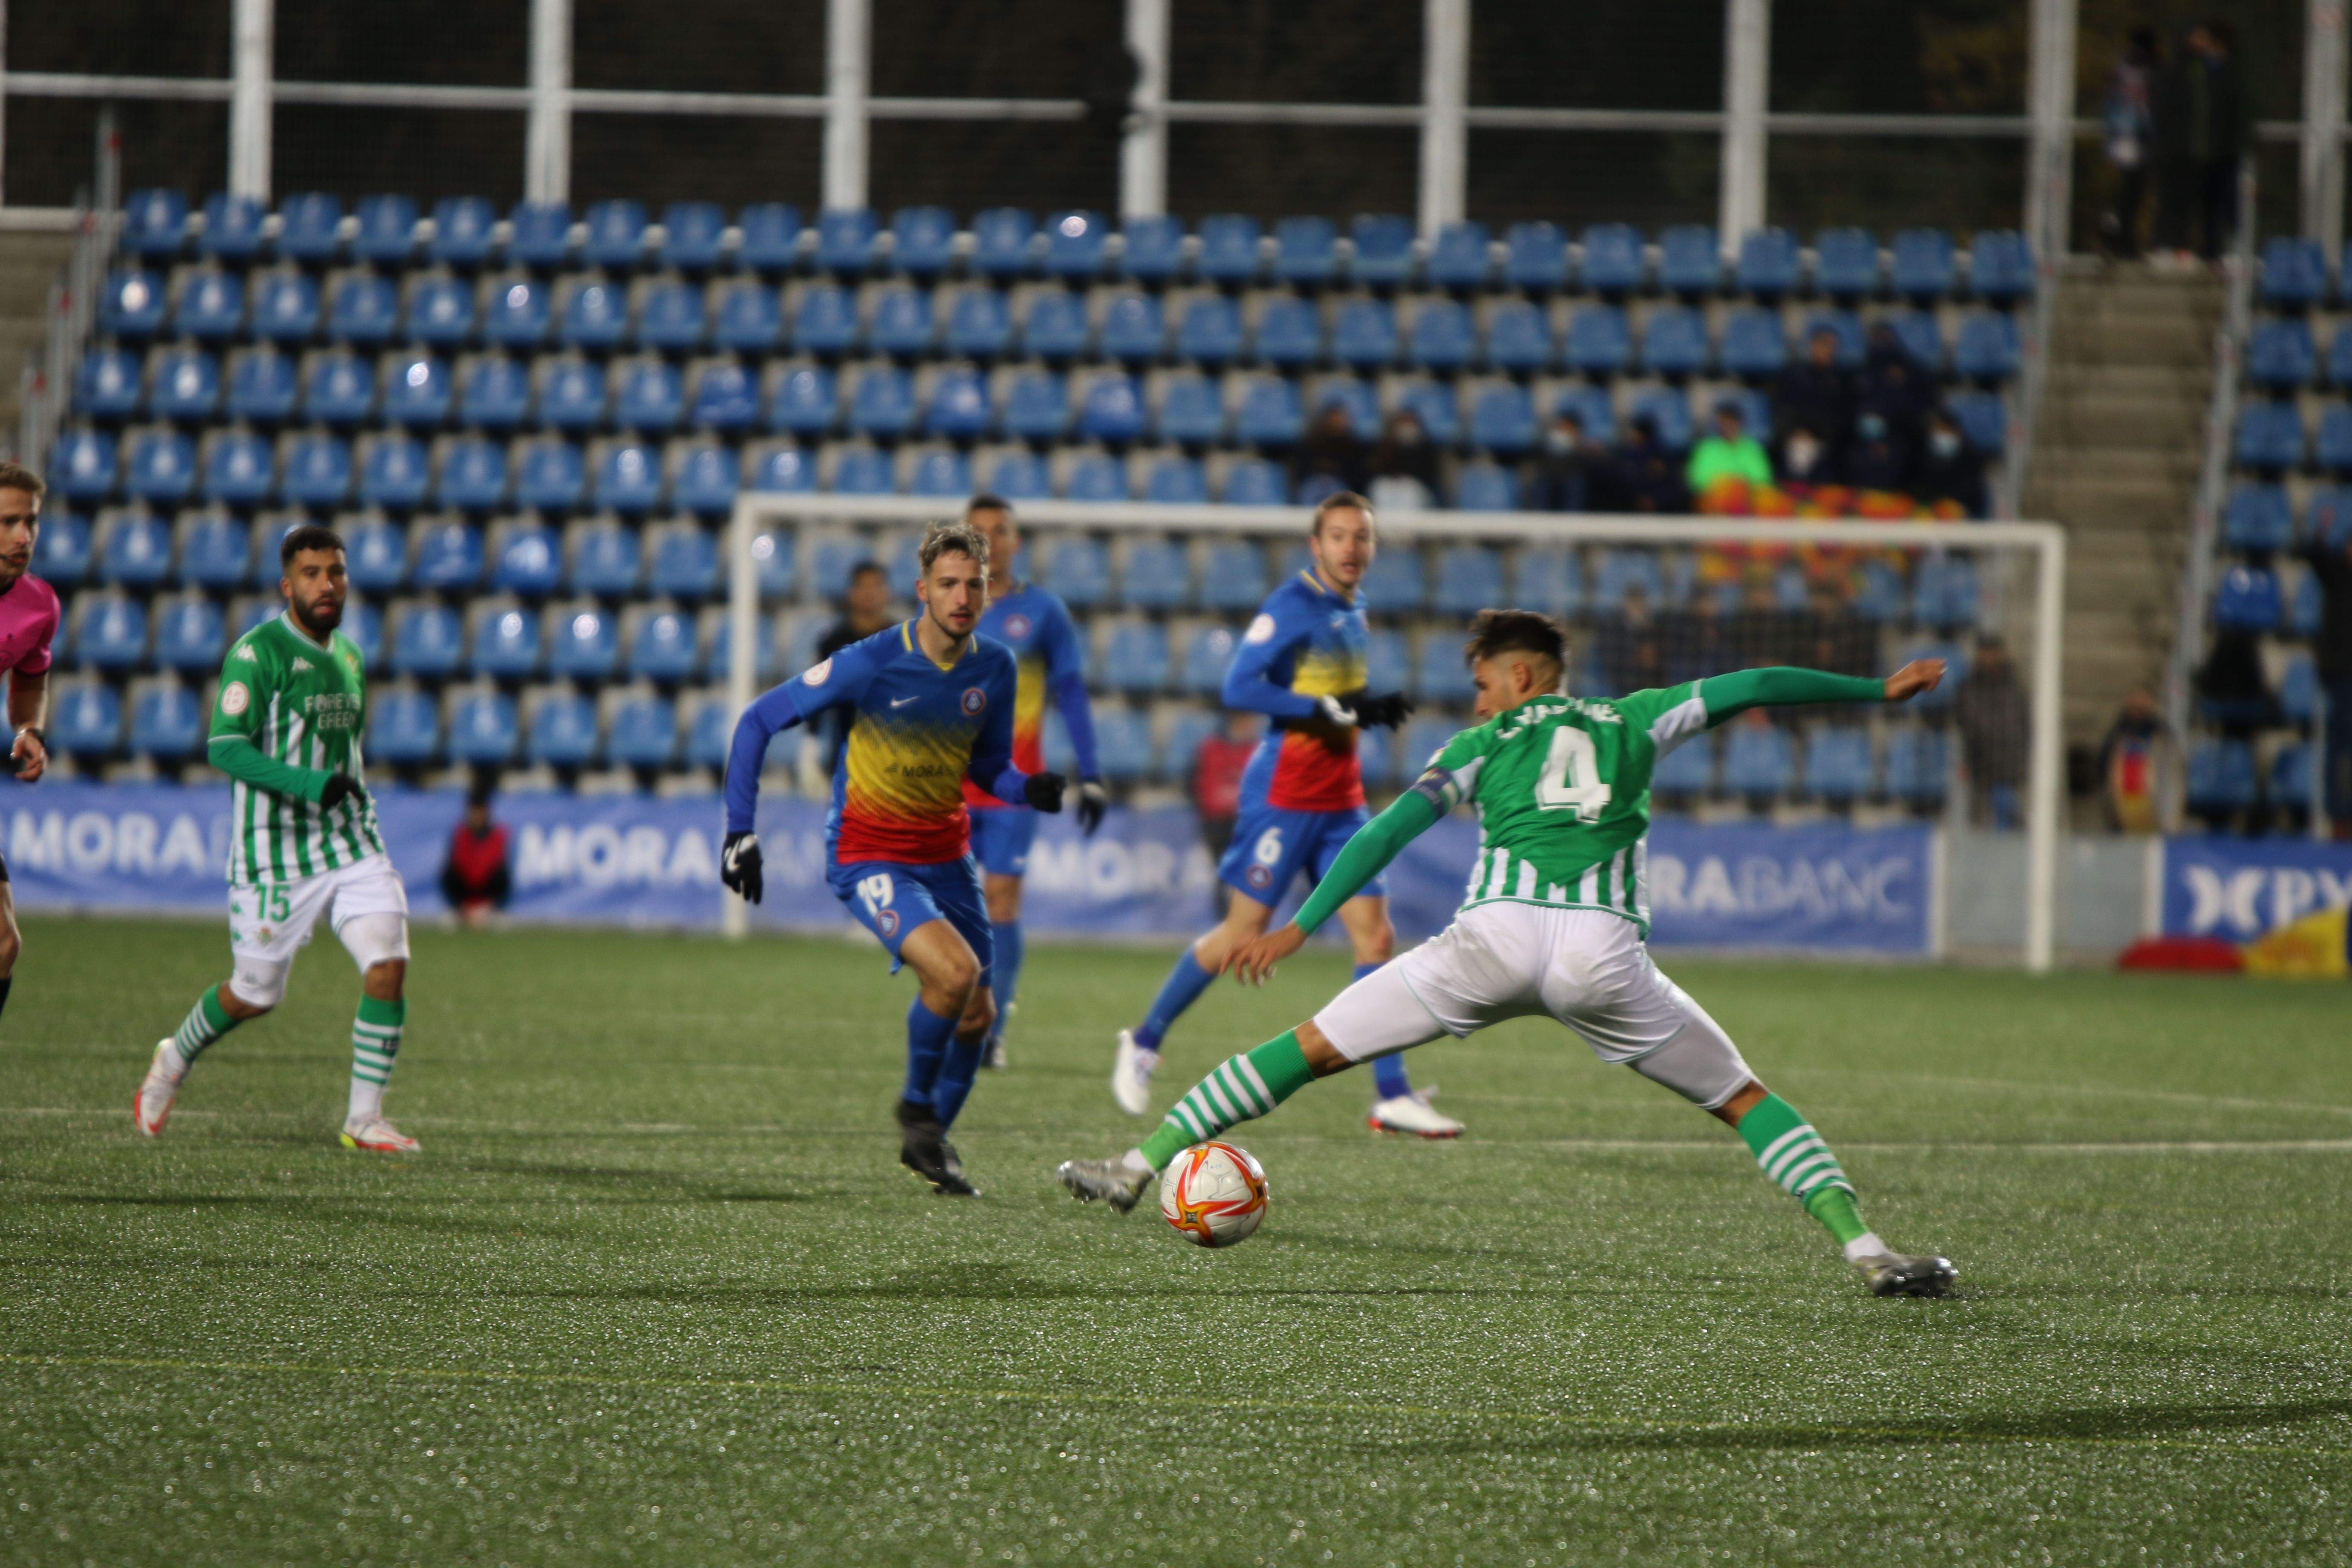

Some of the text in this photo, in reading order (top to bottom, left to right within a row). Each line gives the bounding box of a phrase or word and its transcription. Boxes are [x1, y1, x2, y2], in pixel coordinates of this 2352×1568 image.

[1535, 725, 1611, 824] 4
[1255, 827, 1283, 865] 6
[254, 883, 291, 922] 15
[856, 873, 894, 918] 19
[1650, 855, 1914, 922] RABANC
